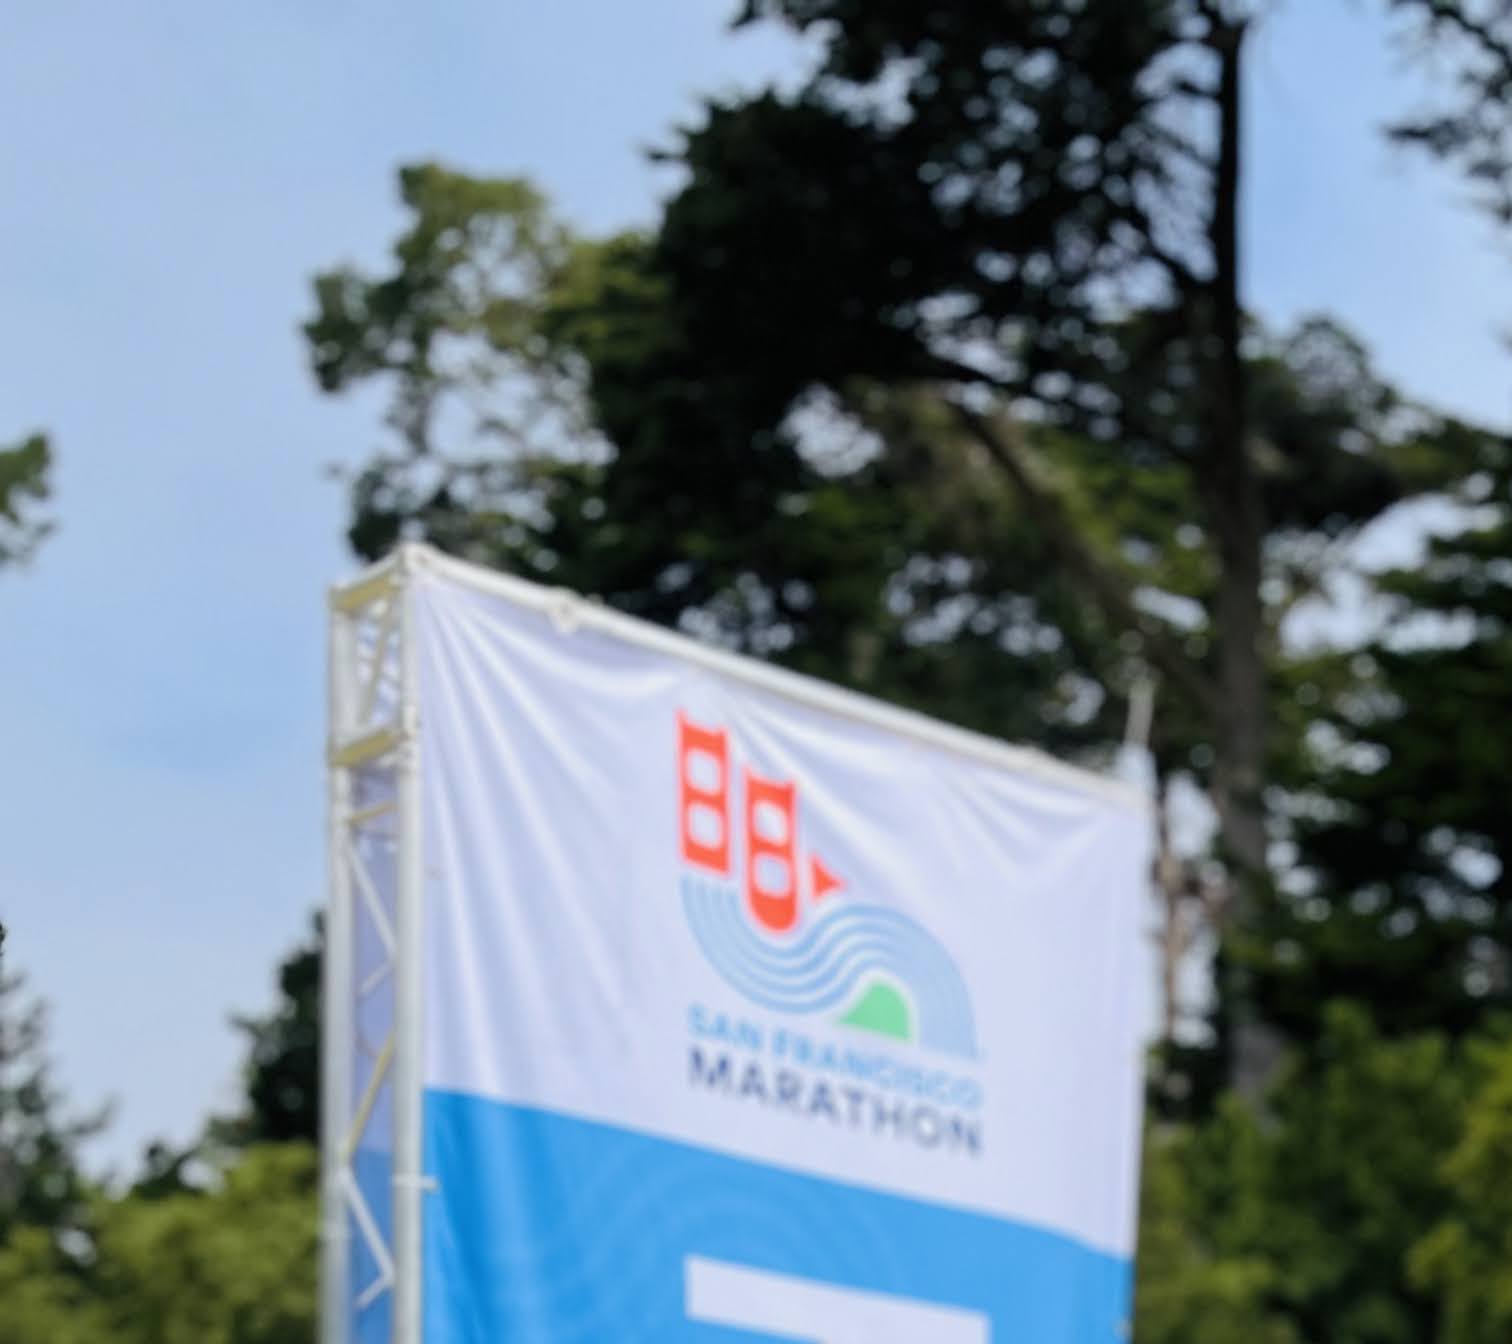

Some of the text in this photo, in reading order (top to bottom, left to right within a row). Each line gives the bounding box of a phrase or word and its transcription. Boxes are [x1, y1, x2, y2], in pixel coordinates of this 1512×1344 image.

[688, 1001, 982, 1107] SAN FRANCISCO
[688, 1046, 982, 1155] MARATHON
